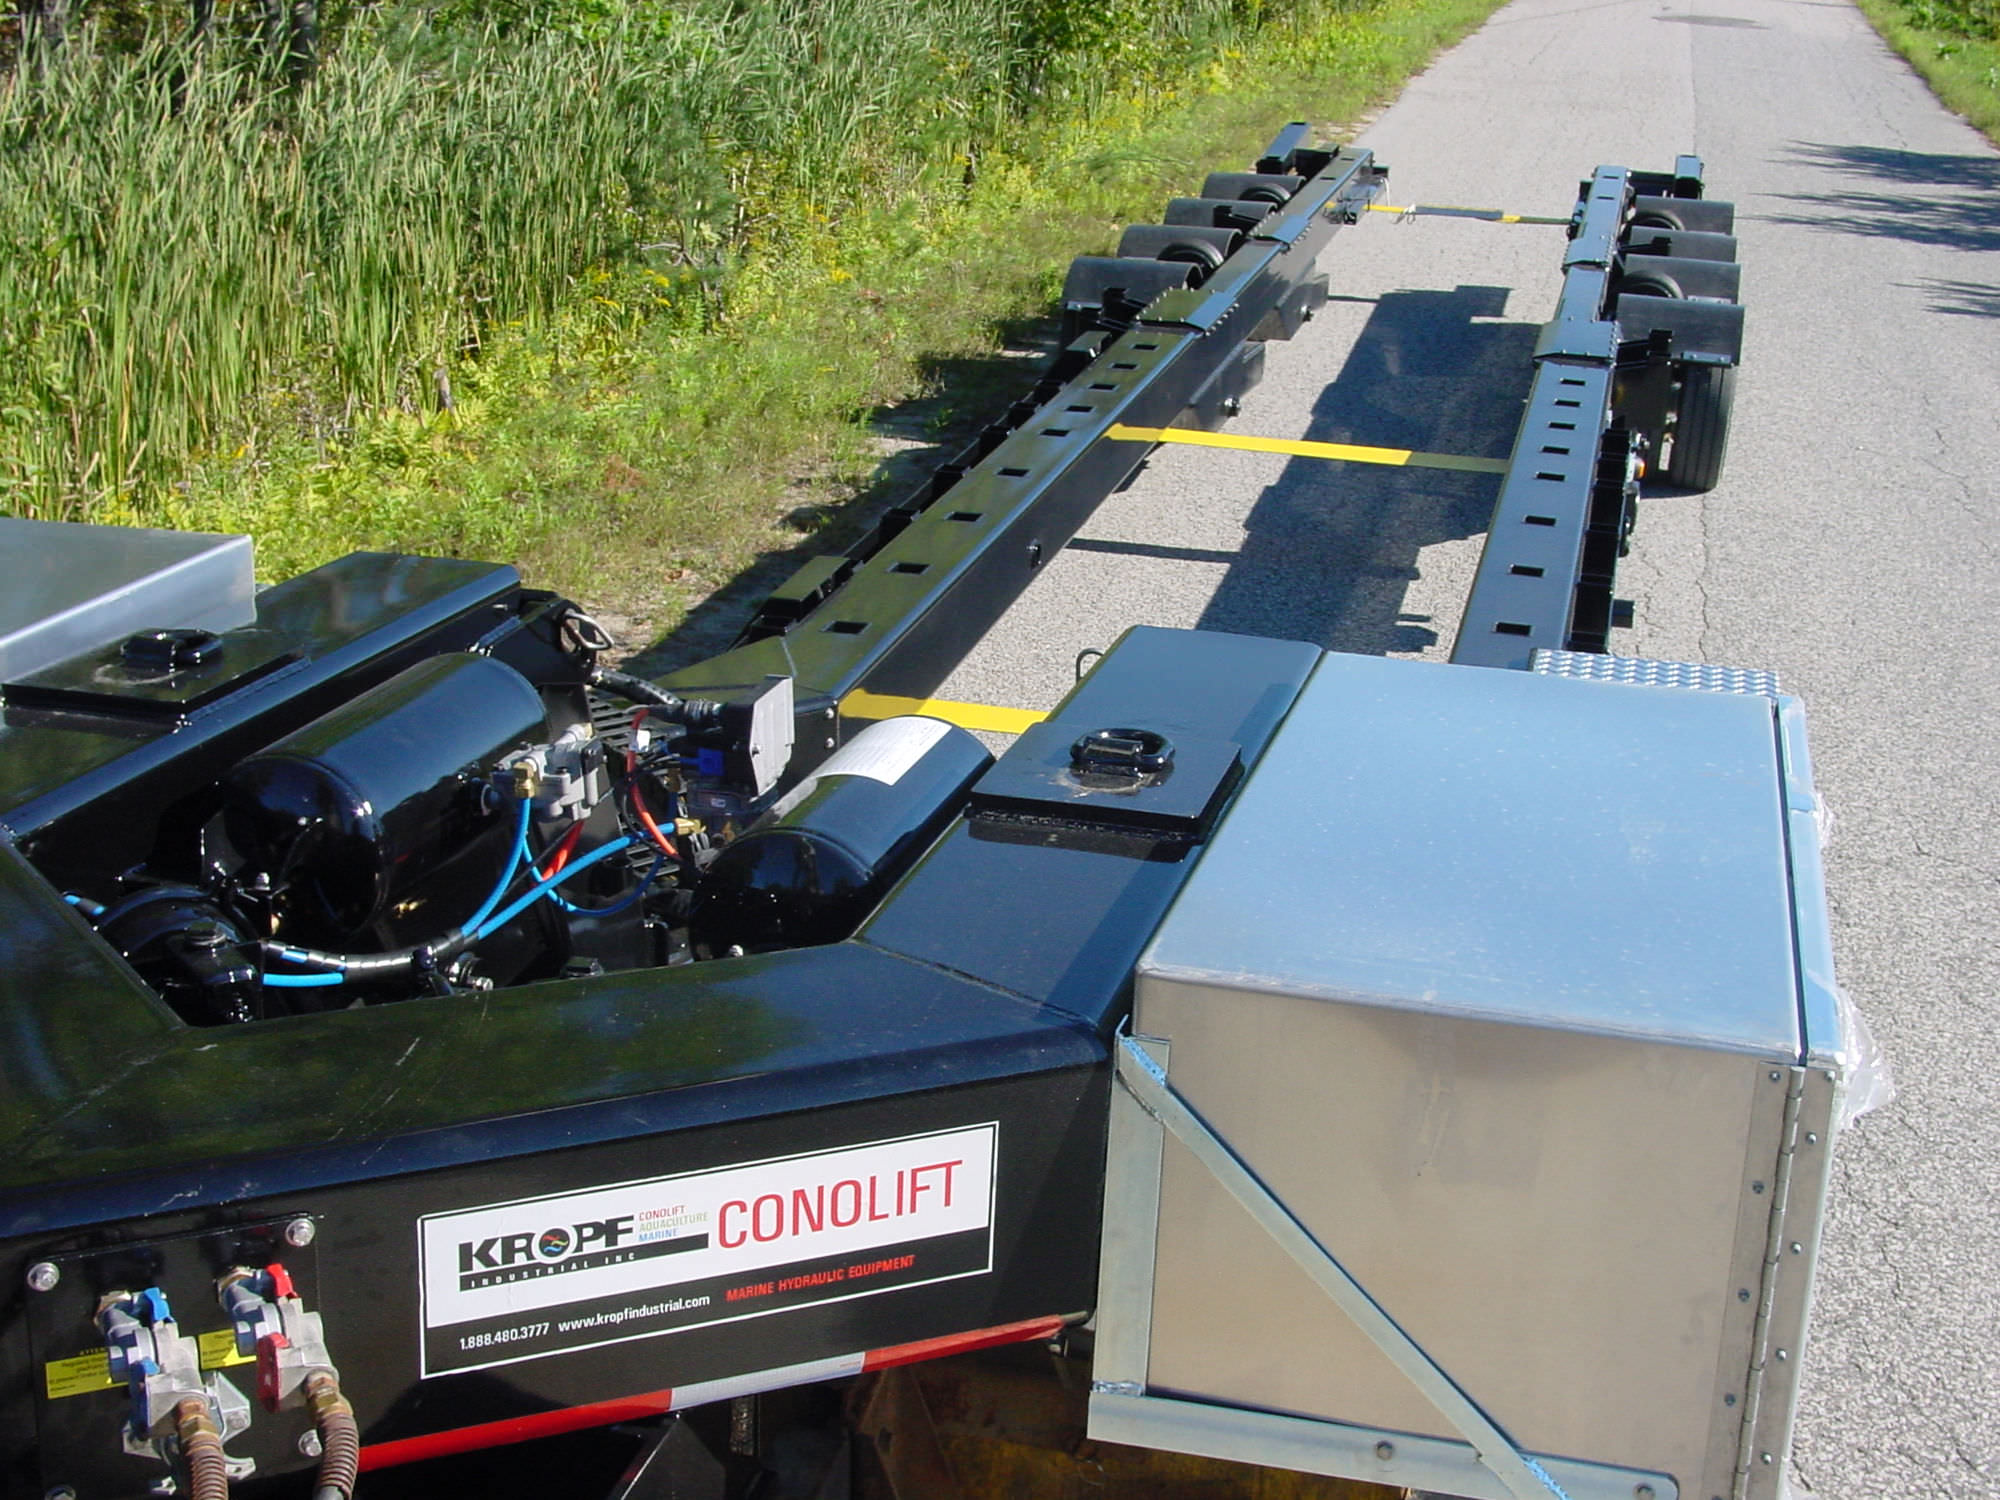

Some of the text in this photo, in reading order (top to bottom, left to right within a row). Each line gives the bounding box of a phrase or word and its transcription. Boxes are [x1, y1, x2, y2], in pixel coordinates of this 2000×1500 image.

[639, 1205, 686, 1221] CONOLIFT
[640, 1212, 708, 1231] AQUACULTURE
[718, 1160, 962, 1248] CONOLIFT
[459, 1215, 635, 1273] KROPF
[639, 1229, 678, 1241] MARINE
[471, 1252, 635, 1288] INDUSTRIAL INC
[725, 1254, 916, 1302] MARINE HYDRAULIC EQUIPMENT
[460, 1297, 710, 1350] 1.888.480.3777 www.kropfindustrial.com
